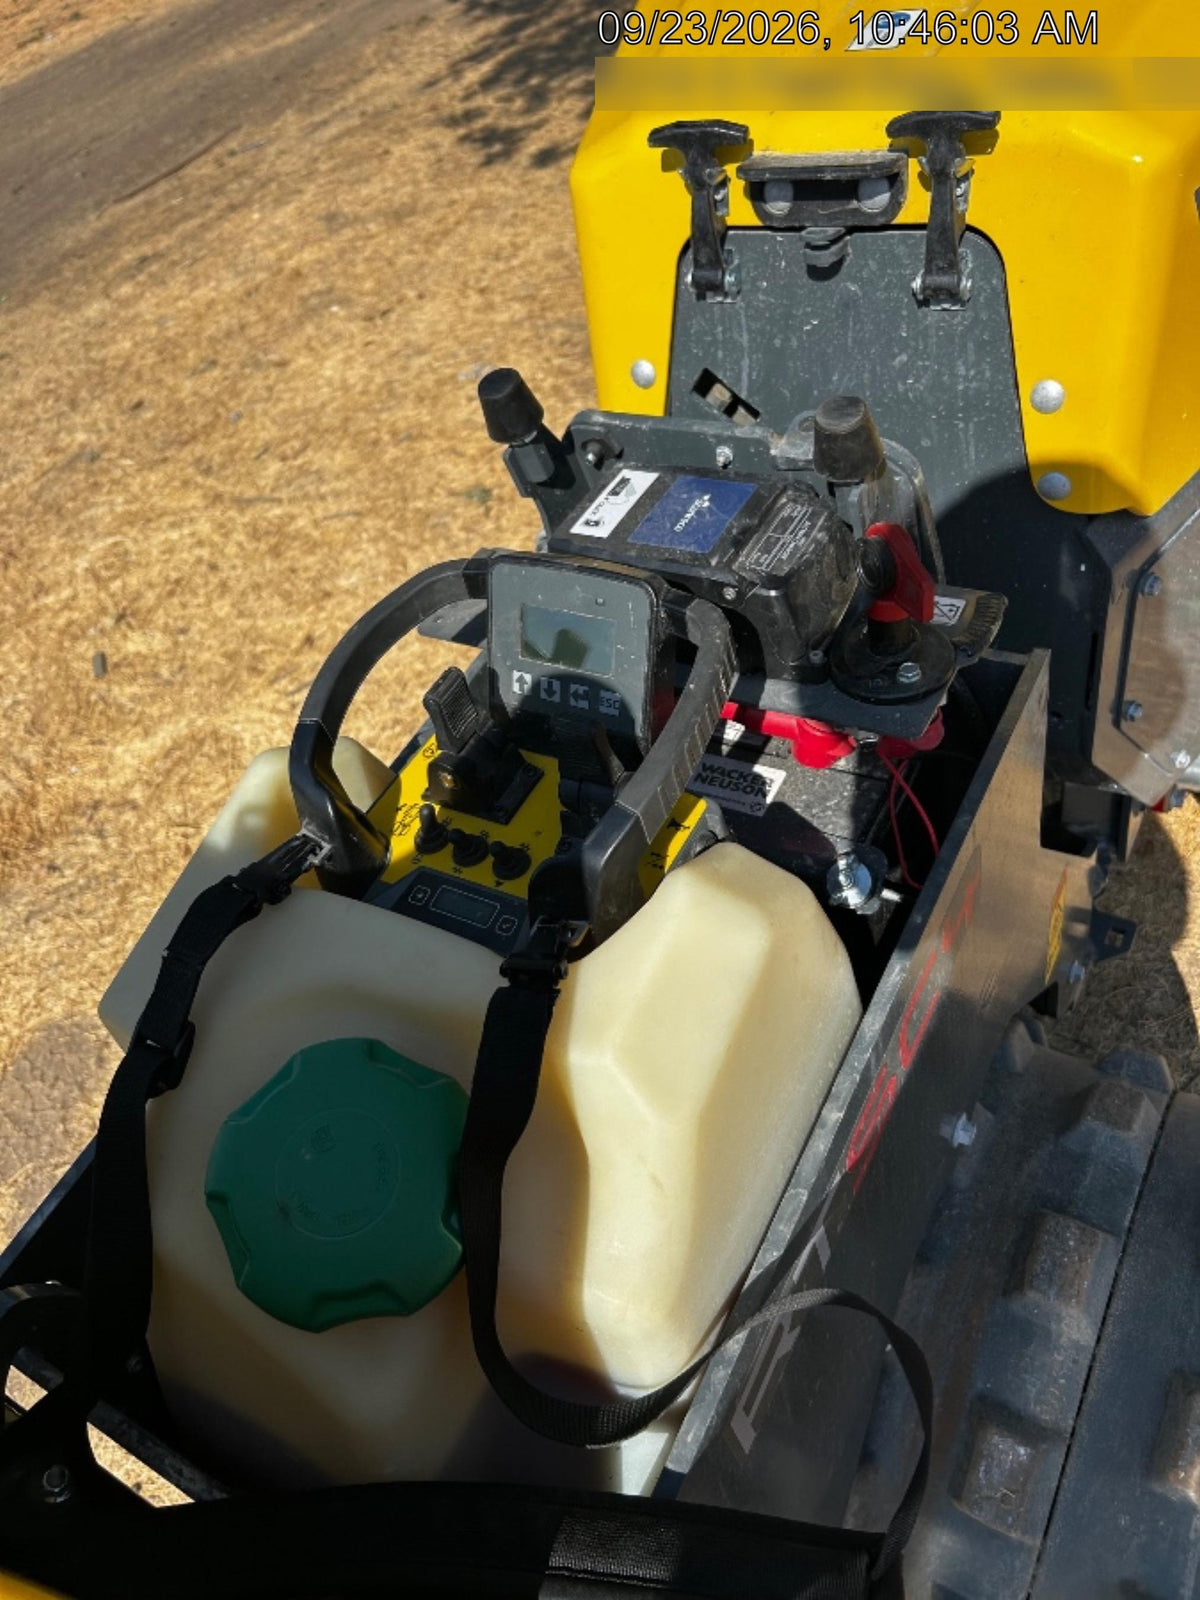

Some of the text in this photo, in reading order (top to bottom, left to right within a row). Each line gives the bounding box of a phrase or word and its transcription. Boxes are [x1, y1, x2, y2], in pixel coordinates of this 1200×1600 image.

[600, 696, 620, 710] ESC
[694, 774, 770, 799] NEUSON
[701, 762, 774, 789] WACKER
